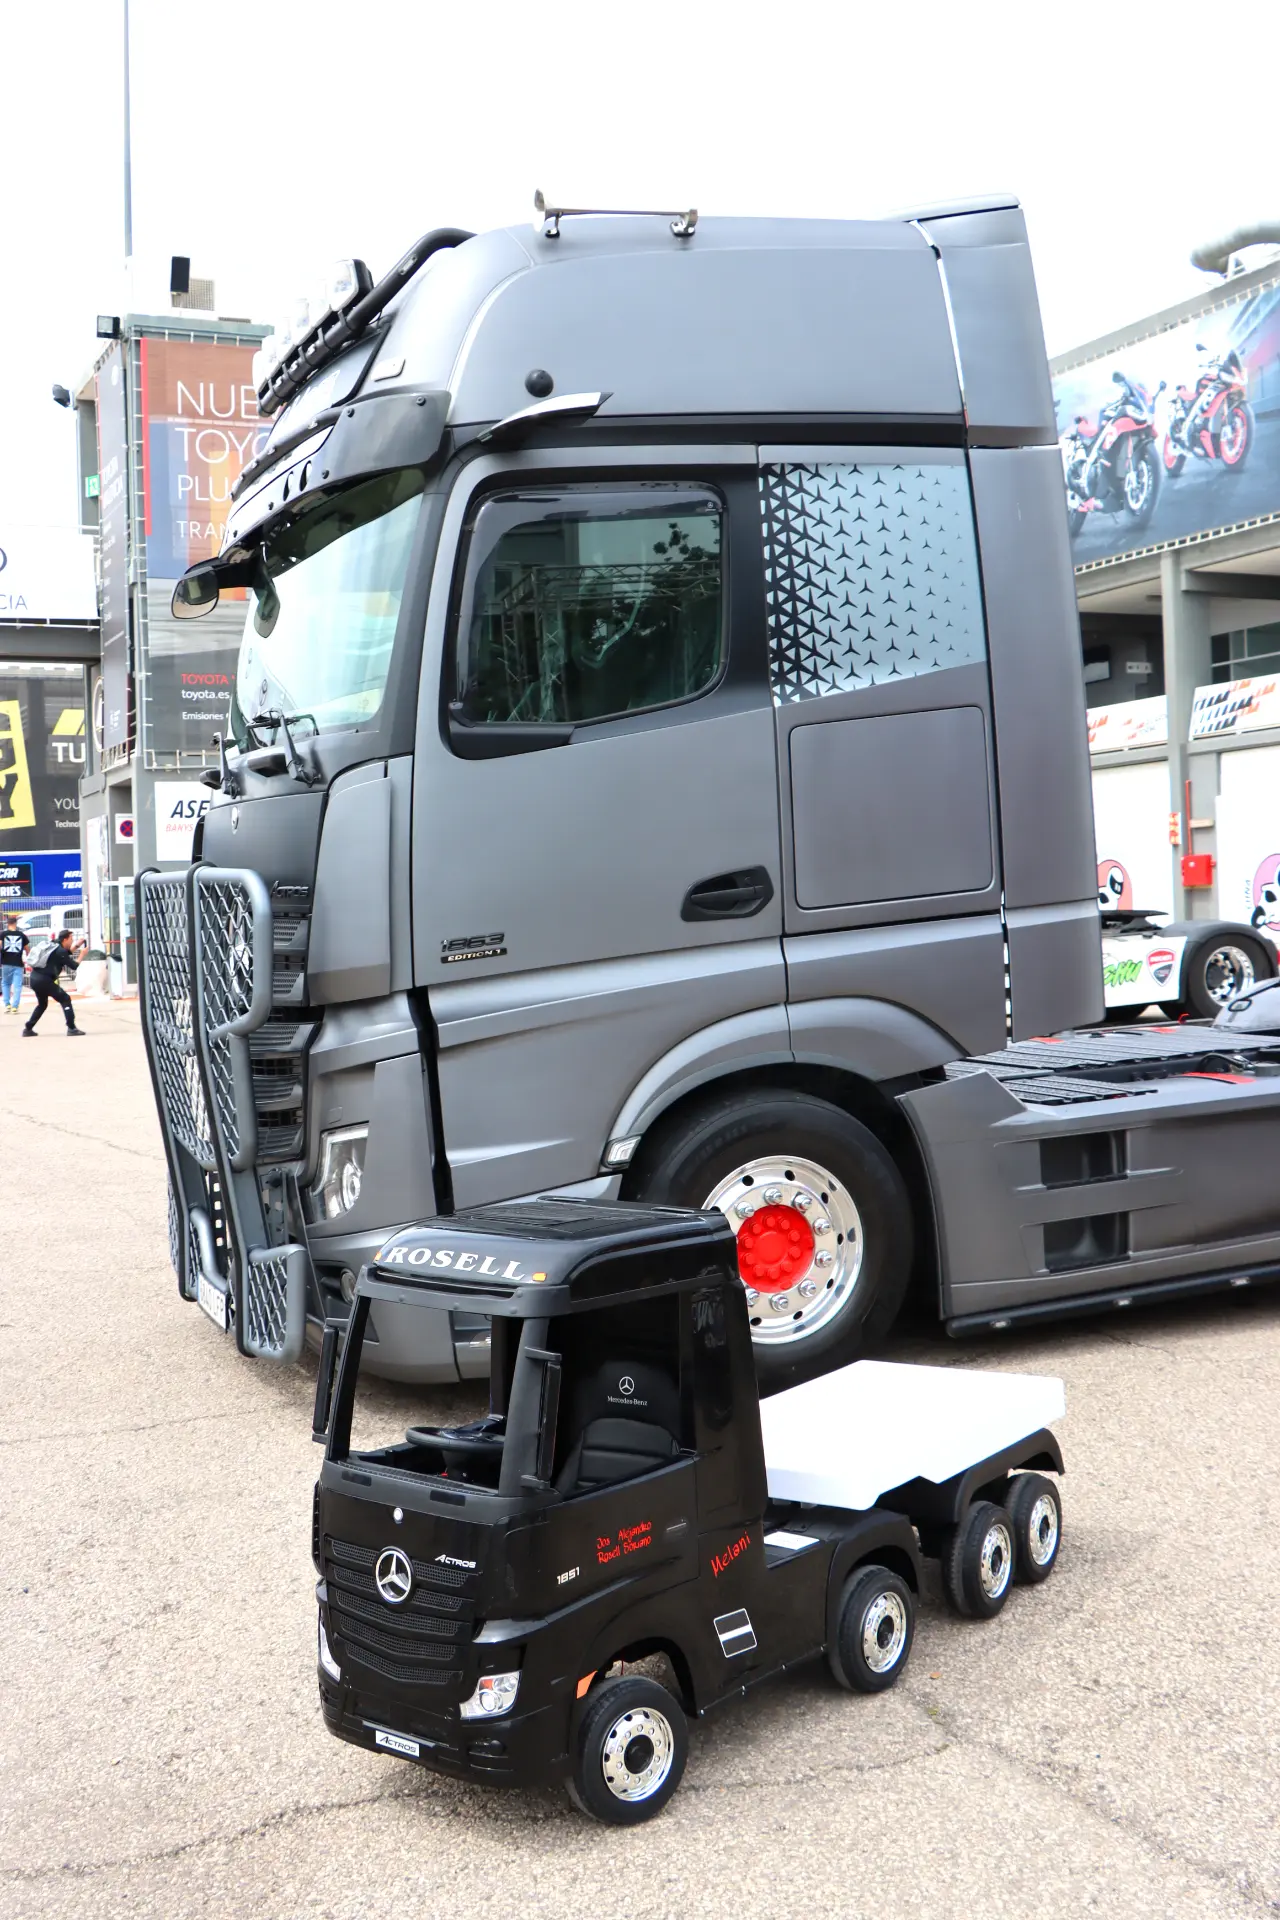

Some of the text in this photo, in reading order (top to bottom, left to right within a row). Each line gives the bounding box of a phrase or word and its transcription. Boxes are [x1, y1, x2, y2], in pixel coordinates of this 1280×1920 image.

[177, 380, 279, 420] NUE
[181, 673, 230, 685] TOYOTA
[181, 689, 230, 701] toyota.es
[182, 711, 225, 720] Emisiones
[52, 742, 86, 763] TU
[441, 932, 505, 953] 1863
[447, 950, 493, 962] EDITION
[383, 1247, 526, 1281] ROSELL
[607, 1395, 648, 1406] Mercedes-Benz
[596, 1544, 621, 1564] Rosell
[710, 1531, 752, 1578] Melani
[556, 1566, 580, 1585] 1851
